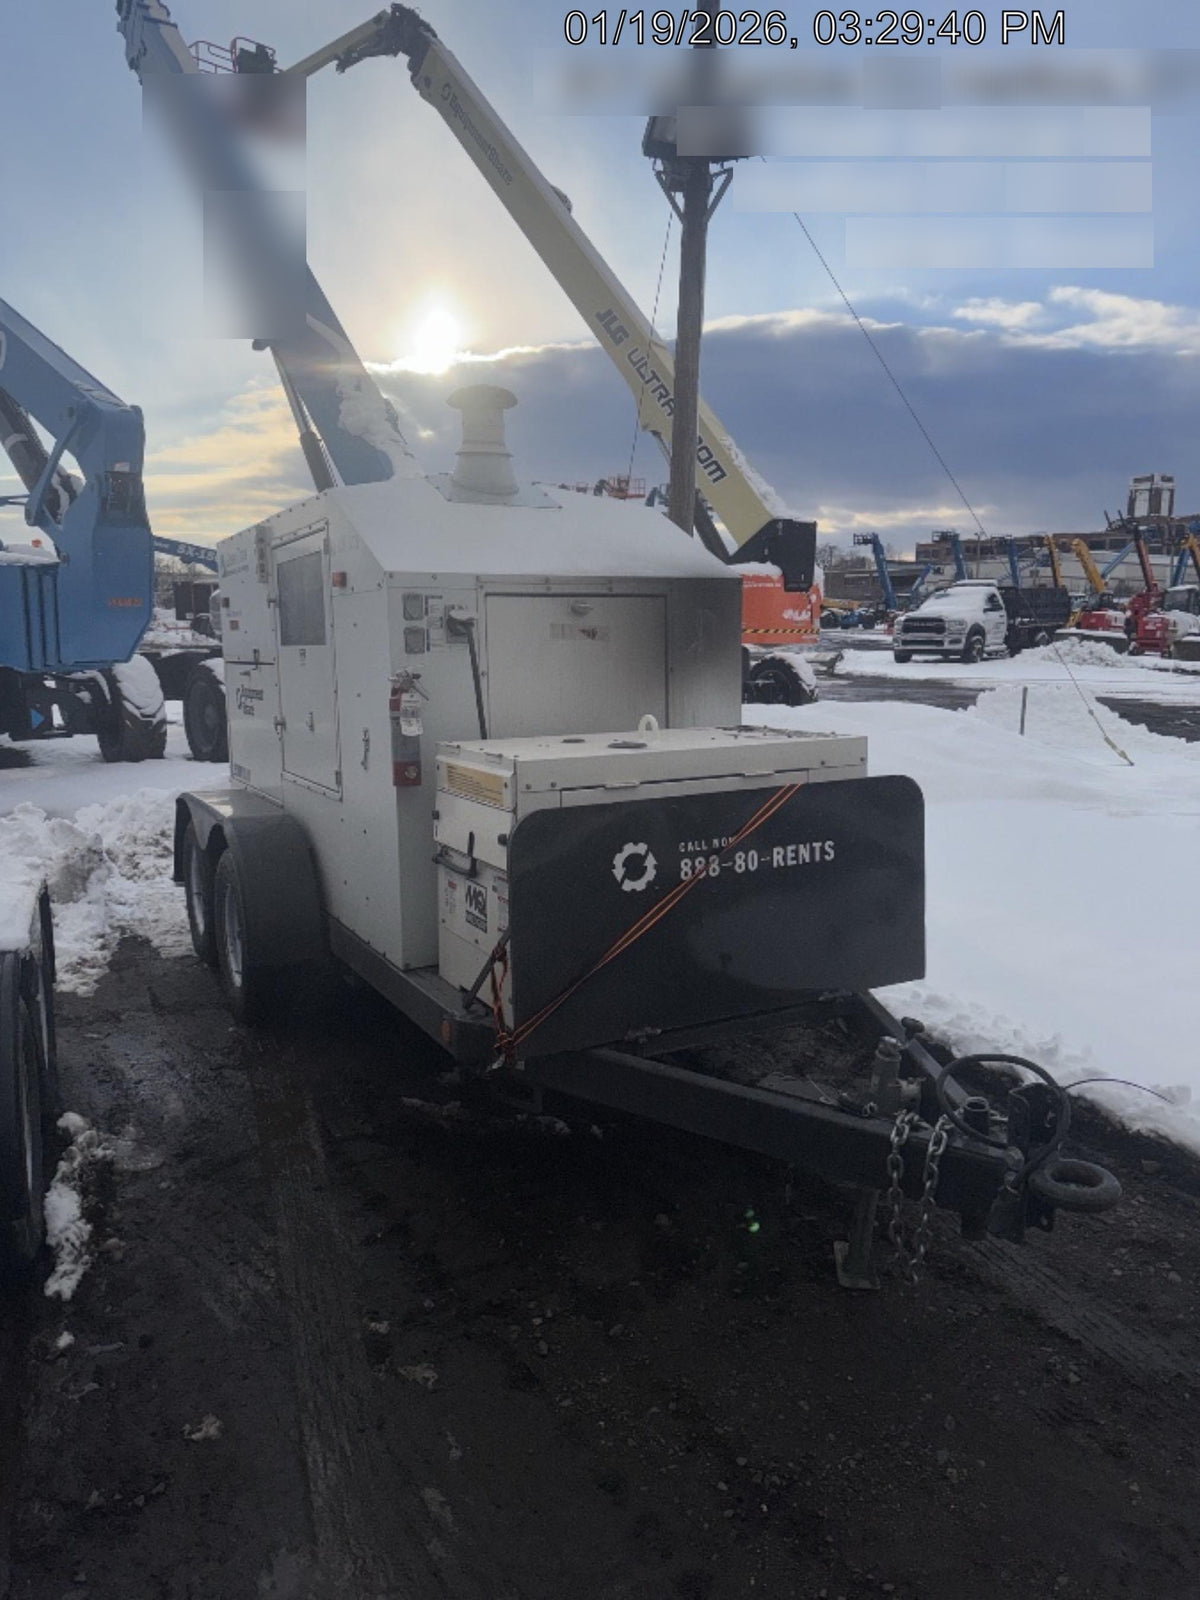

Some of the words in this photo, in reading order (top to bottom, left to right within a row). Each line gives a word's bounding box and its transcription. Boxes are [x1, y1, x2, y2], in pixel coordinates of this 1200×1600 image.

[596, 308, 630, 346] JLG
[678, 840, 708, 853] CALL
[680, 840, 836, 881] 888-80-RENTS
